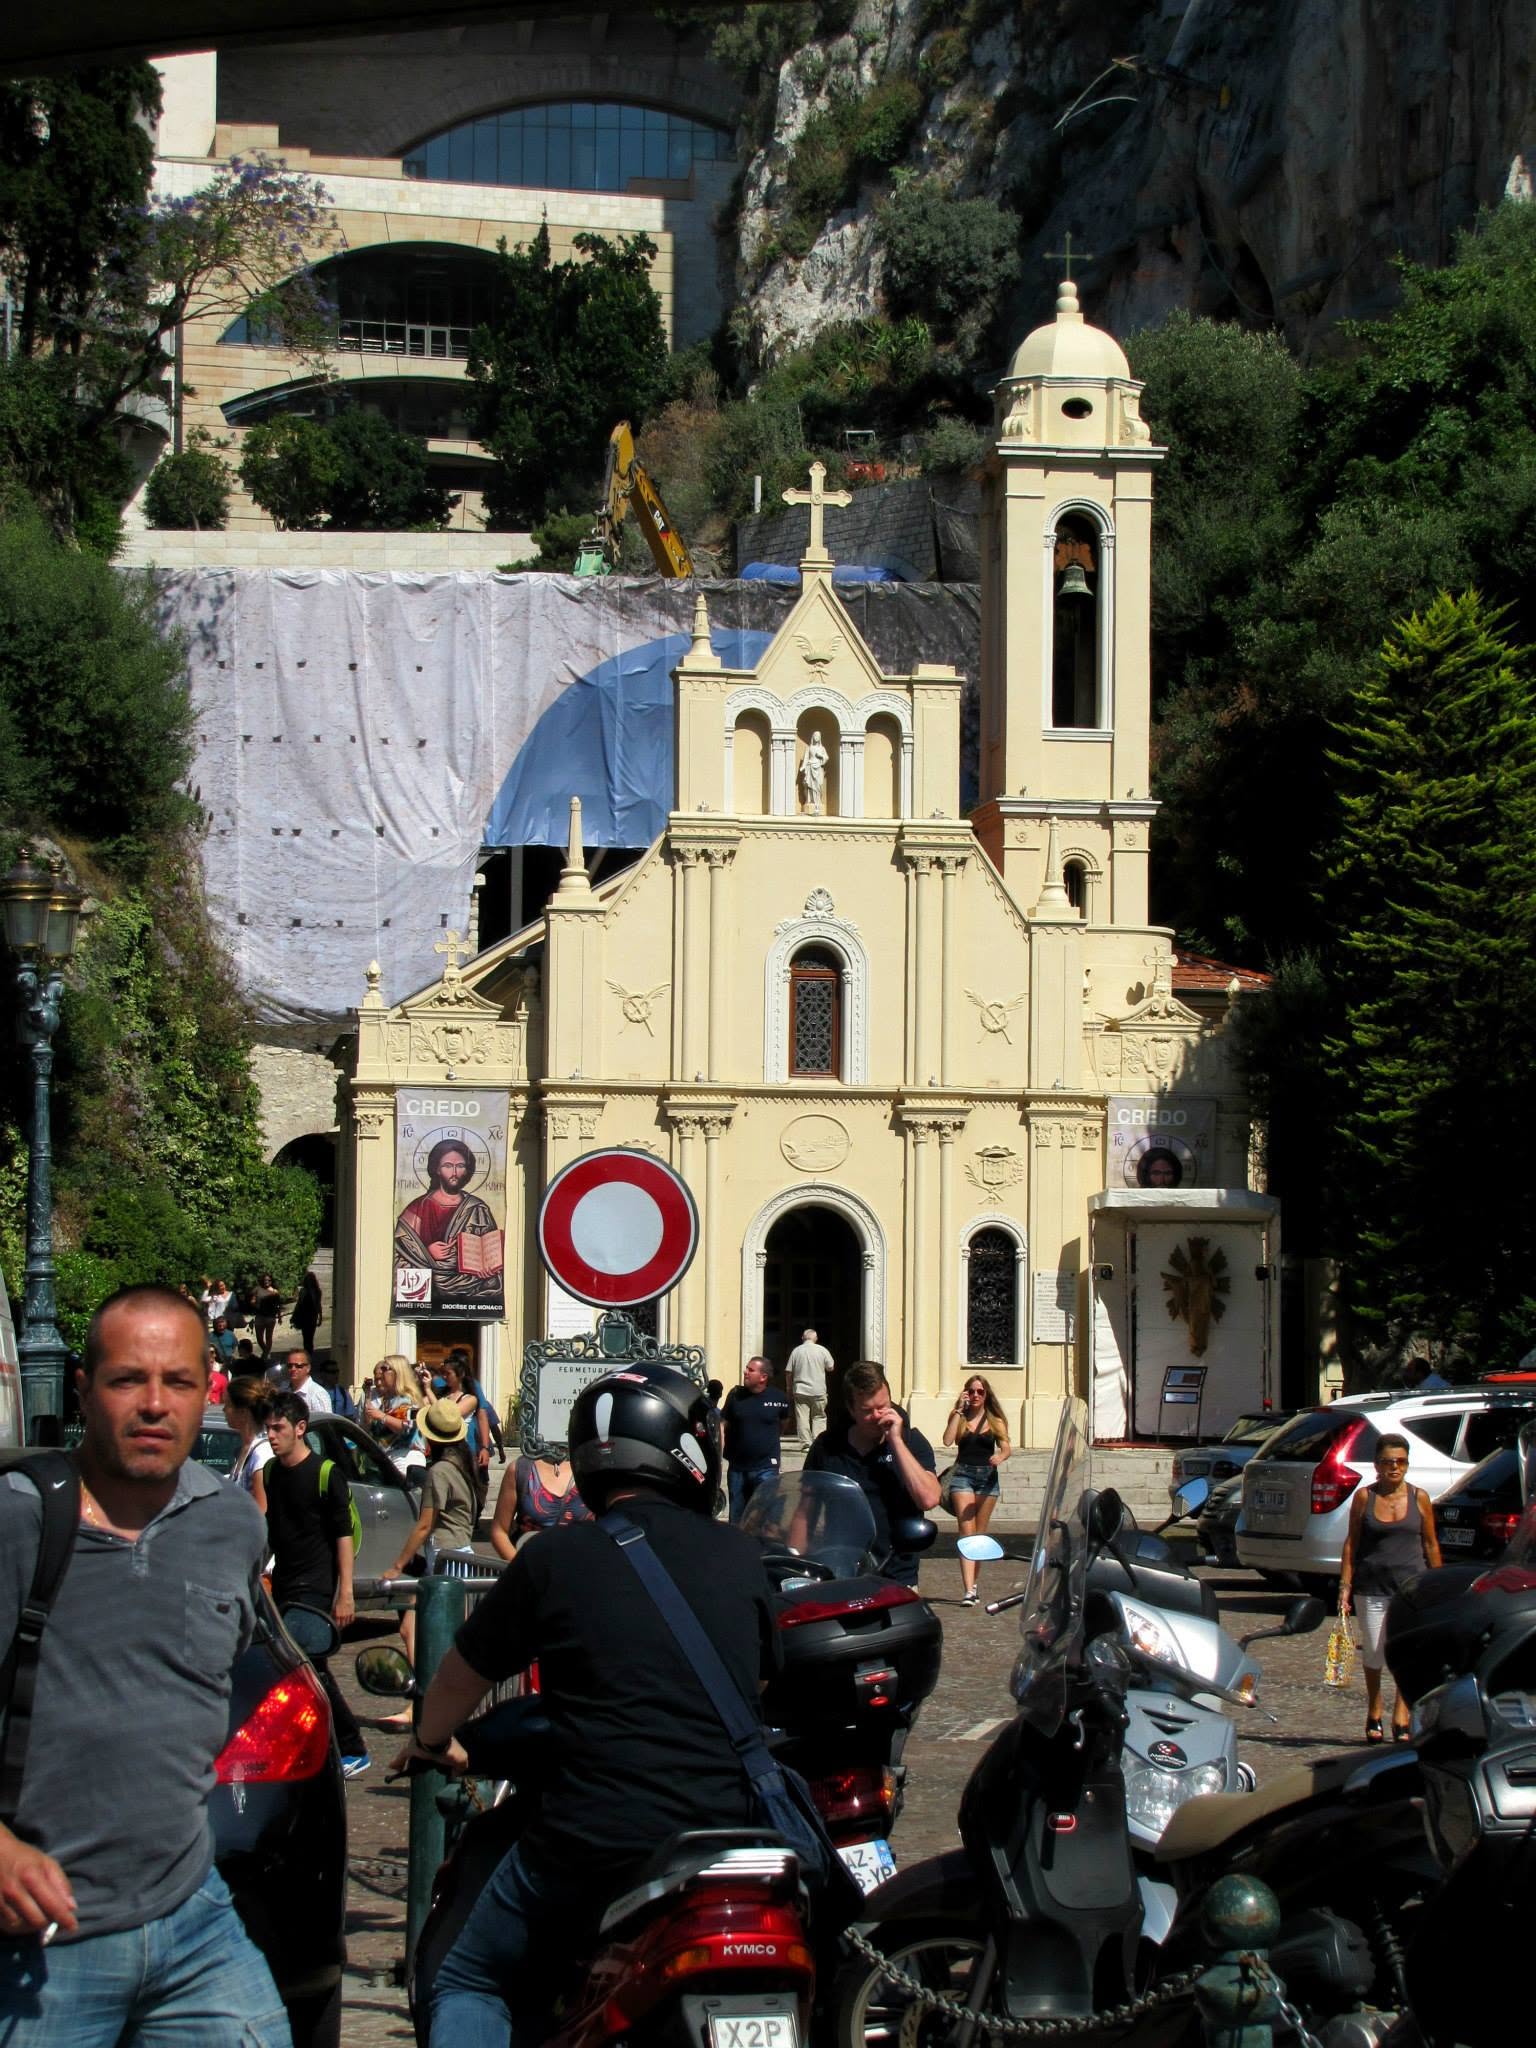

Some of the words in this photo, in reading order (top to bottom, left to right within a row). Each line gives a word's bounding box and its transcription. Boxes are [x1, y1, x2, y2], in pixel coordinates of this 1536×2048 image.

[406, 1099, 481, 1117] CREDO
[1117, 1108, 1187, 1125] CREDO
[723, 1944, 776, 1956] KYMCO
[725, 2020, 782, 2048] X2P
